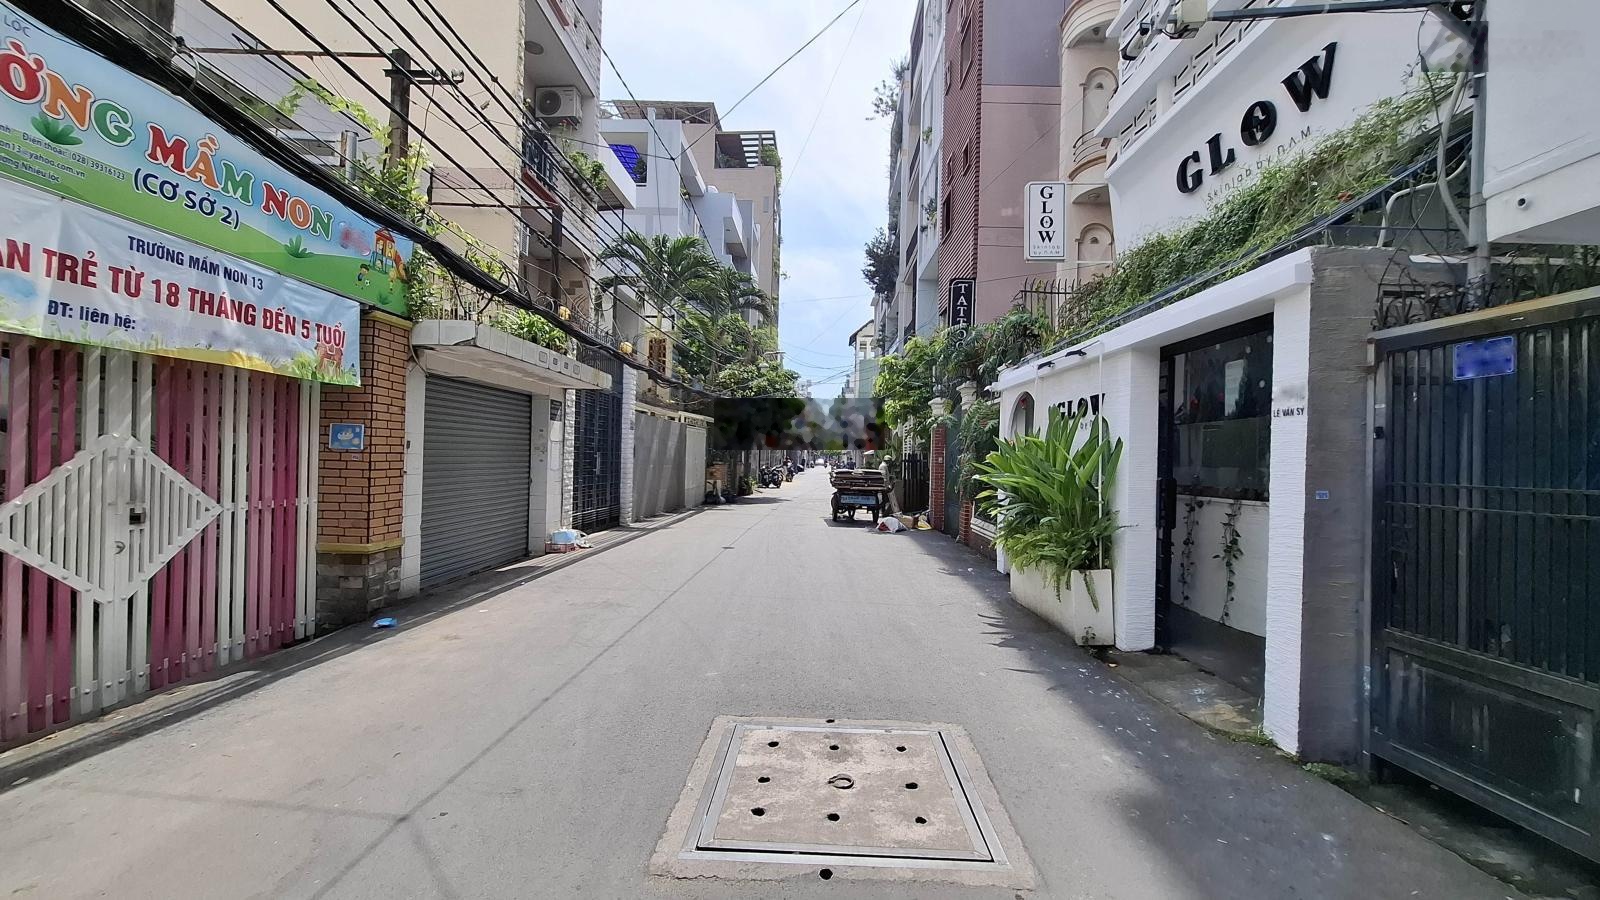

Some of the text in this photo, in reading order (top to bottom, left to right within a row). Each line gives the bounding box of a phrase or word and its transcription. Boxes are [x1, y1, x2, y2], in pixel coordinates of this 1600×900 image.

[1176, 41, 1337, 194] GLOW
[90, 160, 125, 181] 39316123
[133, 167, 240, 230] (CƠ SỞ 2)
[145, 122, 254, 205] MẦM
[261, 181, 334, 240] NON
[1038, 185, 1055, 244] GLOW
[0, 238, 31, 273] N
[42, 248, 98, 289] TRẺ
[108, 265, 145, 298] TỪ
[152, 279, 180, 308] 18
[188, 287, 256, 327] THÁNG
[262, 306, 296, 336] ĐẾN
[301, 319, 310, 340] 5
[315, 321, 346, 348] TUỔI
[128, 235, 185, 266] TRƯỜNG
[223, 267, 247, 285] NON
[251, 276, 264, 290] 13
[48, 299, 136, 331] ĐT: liên hệ:
